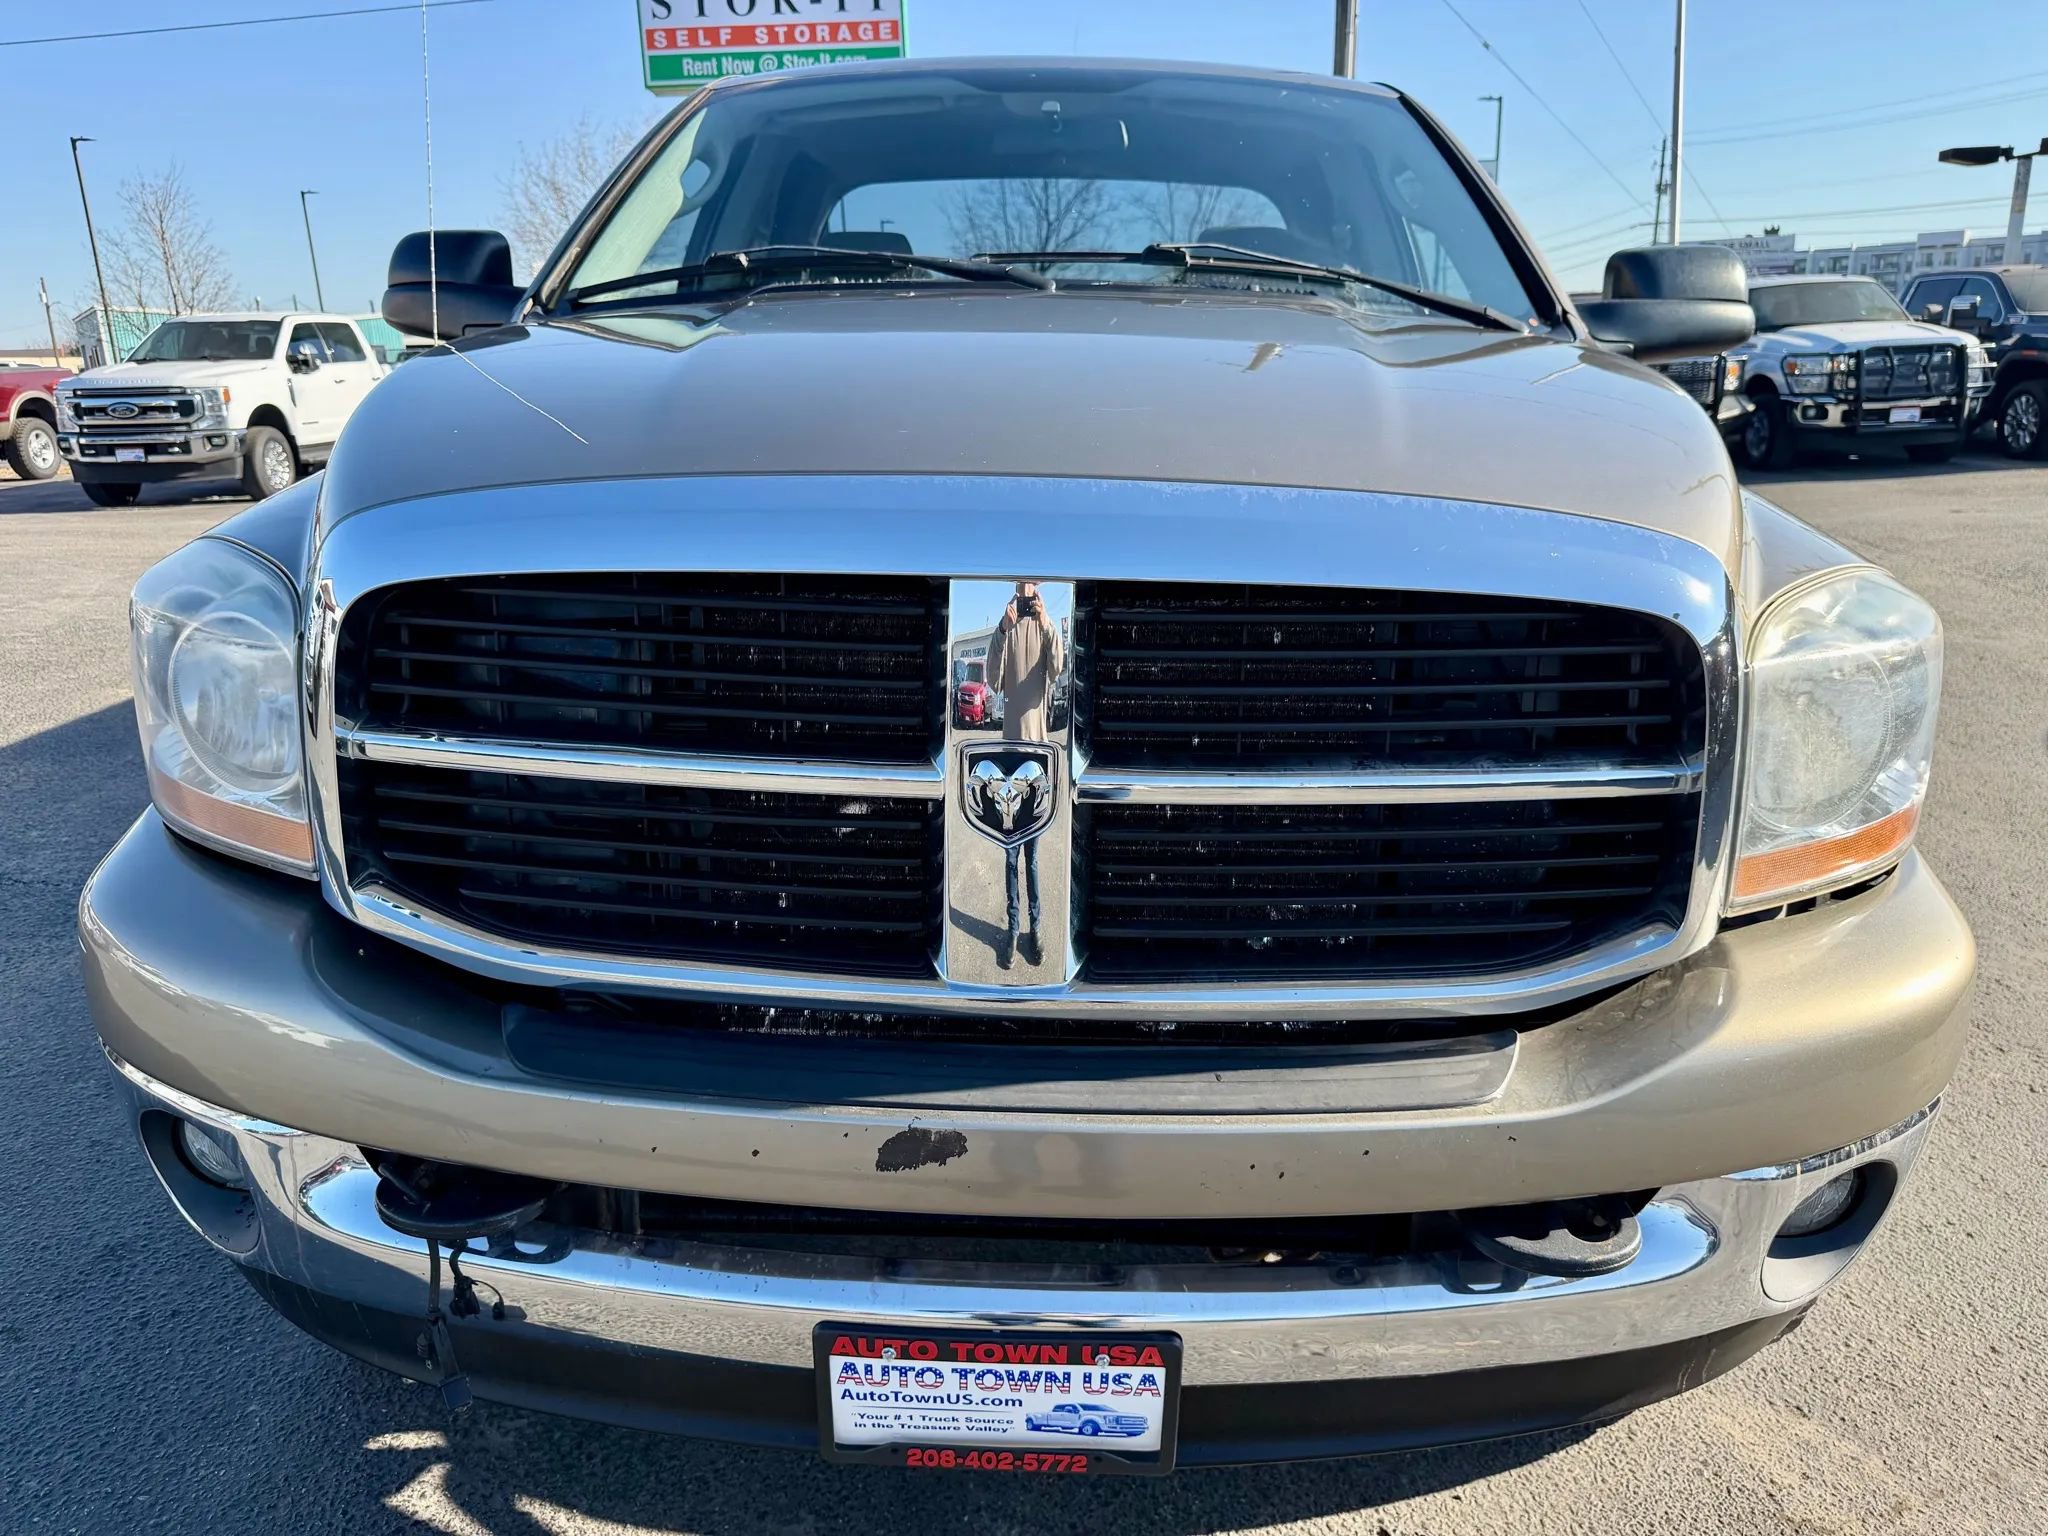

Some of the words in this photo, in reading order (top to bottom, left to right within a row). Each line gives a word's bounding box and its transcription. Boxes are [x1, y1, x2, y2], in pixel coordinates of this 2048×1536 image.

[653, 28, 732, 48] SELF
[754, 22, 894, 45] STORAGE
[682, 57, 718, 77] Rent
[721, 55, 756, 75] Now
[758, 53, 778, 73] @
[830, 1336, 939, 1359] AUTO
[950, 1341, 1069, 1364] TOWN
[1081, 1345, 1166, 1367] USA
[836, 1361, 945, 1389] AUTO
[951, 1367, 1072, 1395] TOWN
[1082, 1371, 1162, 1398] USA
[840, 1388, 1024, 1408] AutoTownUS.com
[853, 1421, 867, 1429] in
[871, 1421, 894, 1429] the
[898, 1422, 961, 1431] Treasure
[919, 1414, 960, 1423] Truck
[964, 1416, 1014, 1425] Source
[905, 1447, 1088, 1473] 208-402-5772
